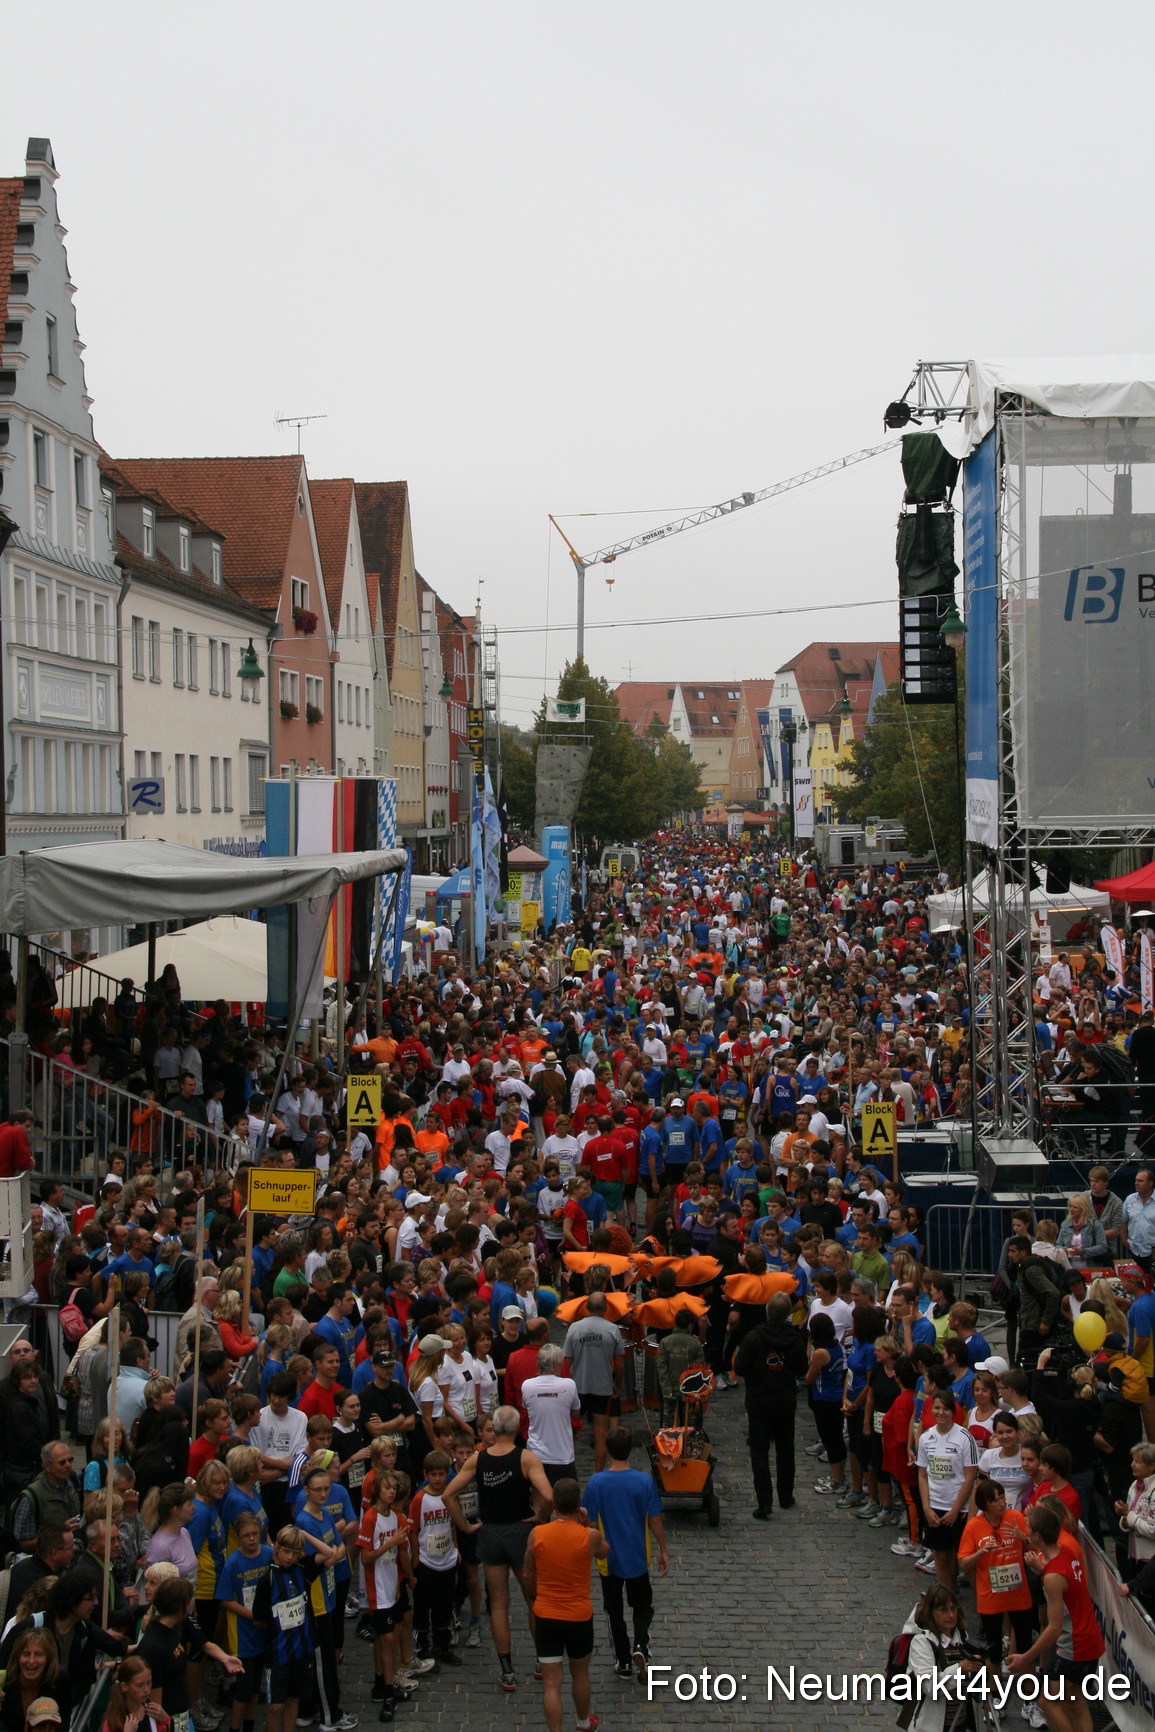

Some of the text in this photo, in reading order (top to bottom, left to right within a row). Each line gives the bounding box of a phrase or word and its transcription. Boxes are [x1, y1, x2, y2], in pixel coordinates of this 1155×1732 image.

[642, 529, 665, 541] POTAIN
[469, 710, 484, 788] HOTE
[794, 778, 811, 786] swn
[611, 864, 618, 873] B
[783, 862, 789, 872] B
[351, 1077, 377, 1087] Block
[354, 1090, 374, 1115] A
[865, 1104, 893, 1114] Block
[870, 1118, 890, 1143] A
[253, 1180, 311, 1192] Schnupper-
[272, 1193, 291, 1202] lauf
[935, 1464, 953, 1472] 5202
[483, 1471, 506, 1482] Marathon
[483, 1470, 513, 1487] Regensburg
[1000, 1573, 1019, 1583] 5214
